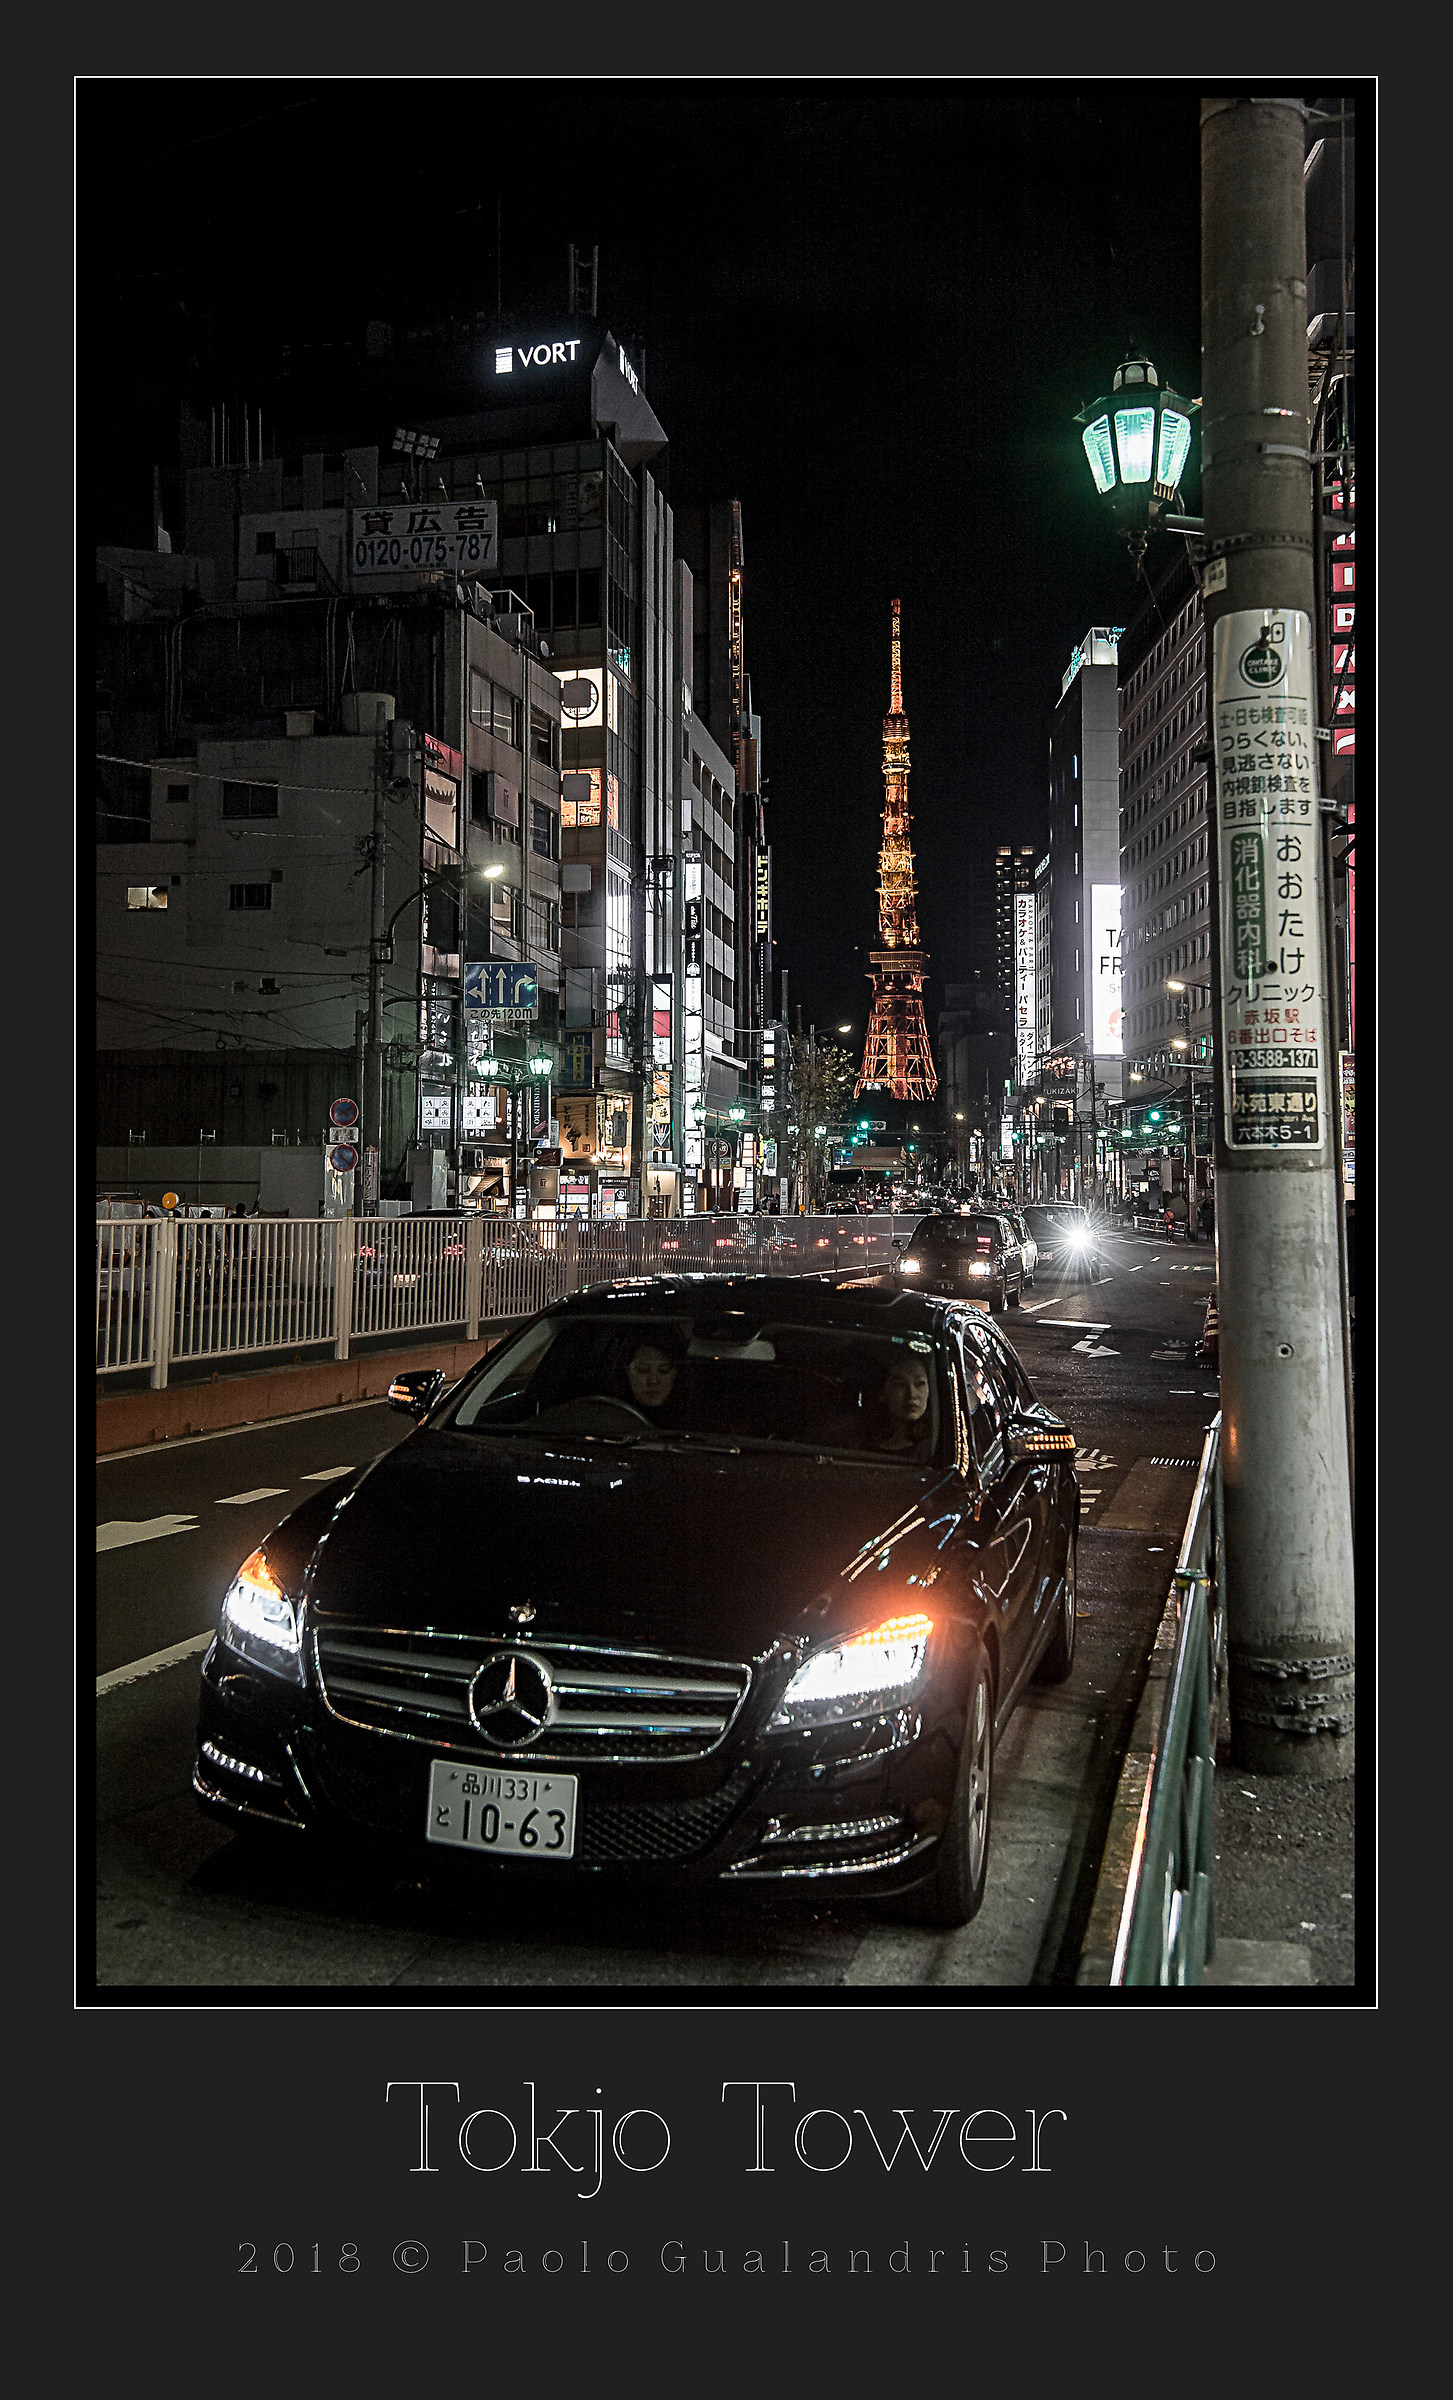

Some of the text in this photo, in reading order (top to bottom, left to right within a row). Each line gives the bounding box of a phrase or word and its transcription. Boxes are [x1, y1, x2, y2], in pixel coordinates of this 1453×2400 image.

[517, 339, 581, 368] VORT
[360, 505, 489, 537] 貸広告
[355, 533, 493, 568] 0120-075-787
[1221, 752, 1310, 776] 見逃さない
[1222, 774, 1311, 798] 内視鏡検査を
[1222, 797, 1312, 820] 目指します
[1234, 837, 1263, 976] 消化器内科
[1276, 834, 1306, 975] おおたけ
[1227, 983, 1315, 1006] クリニック
[470, 1008, 533, 1019] この先120m
[1243, 1008, 1300, 1026] 赤坂駅
[1227, 1028, 1318, 1045] 6番出口そば
[436, 1798, 568, 1850] と 10-63
